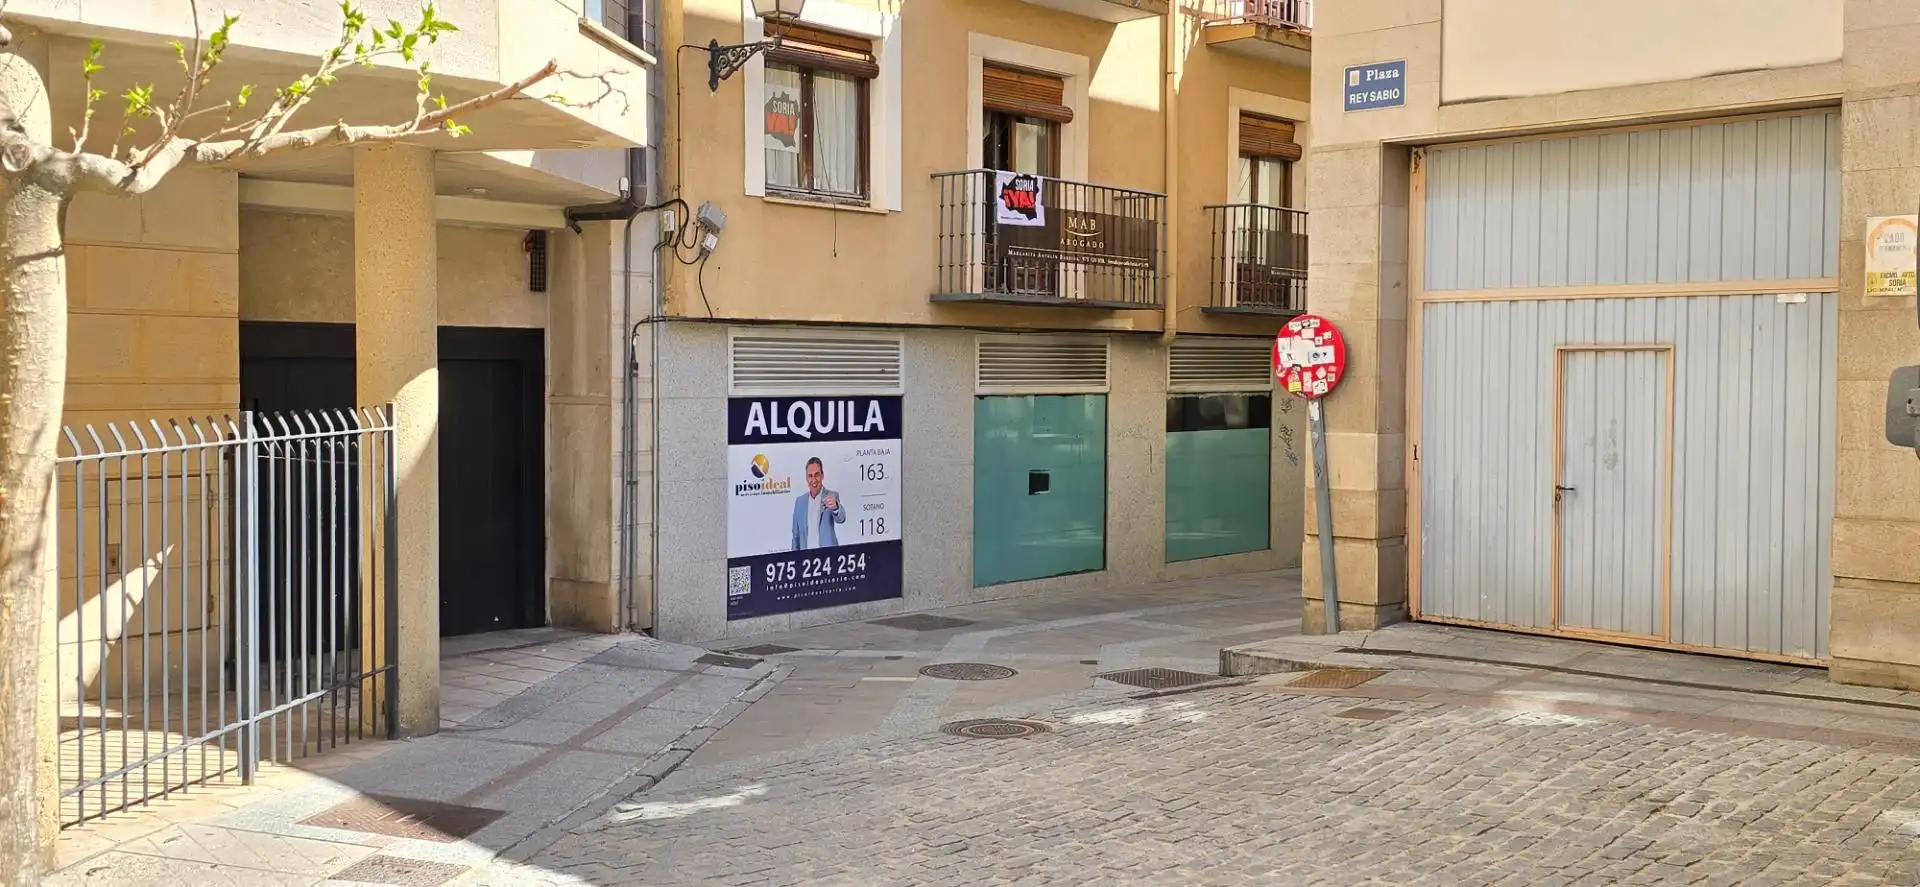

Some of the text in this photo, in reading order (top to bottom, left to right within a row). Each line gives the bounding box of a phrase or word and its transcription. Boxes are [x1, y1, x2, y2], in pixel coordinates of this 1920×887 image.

[1366, 69, 1400, 81] Plaza
[1349, 88, 1400, 104] REY SABIO
[772, 100, 795, 116] SORIA
[1015, 179, 1034, 192] SORIA
[1068, 216, 1097, 231] MAB
[1060, 237, 1105, 249] ABOGADO
[1889, 279, 1907, 287] SORIA
[744, 400, 885, 439] ALQUILA
[860, 463, 884, 481] 163
[735, 477, 791, 496] pisoideal
[860, 517, 885, 536] 118
[766, 553, 866, 583] 975 224 254
